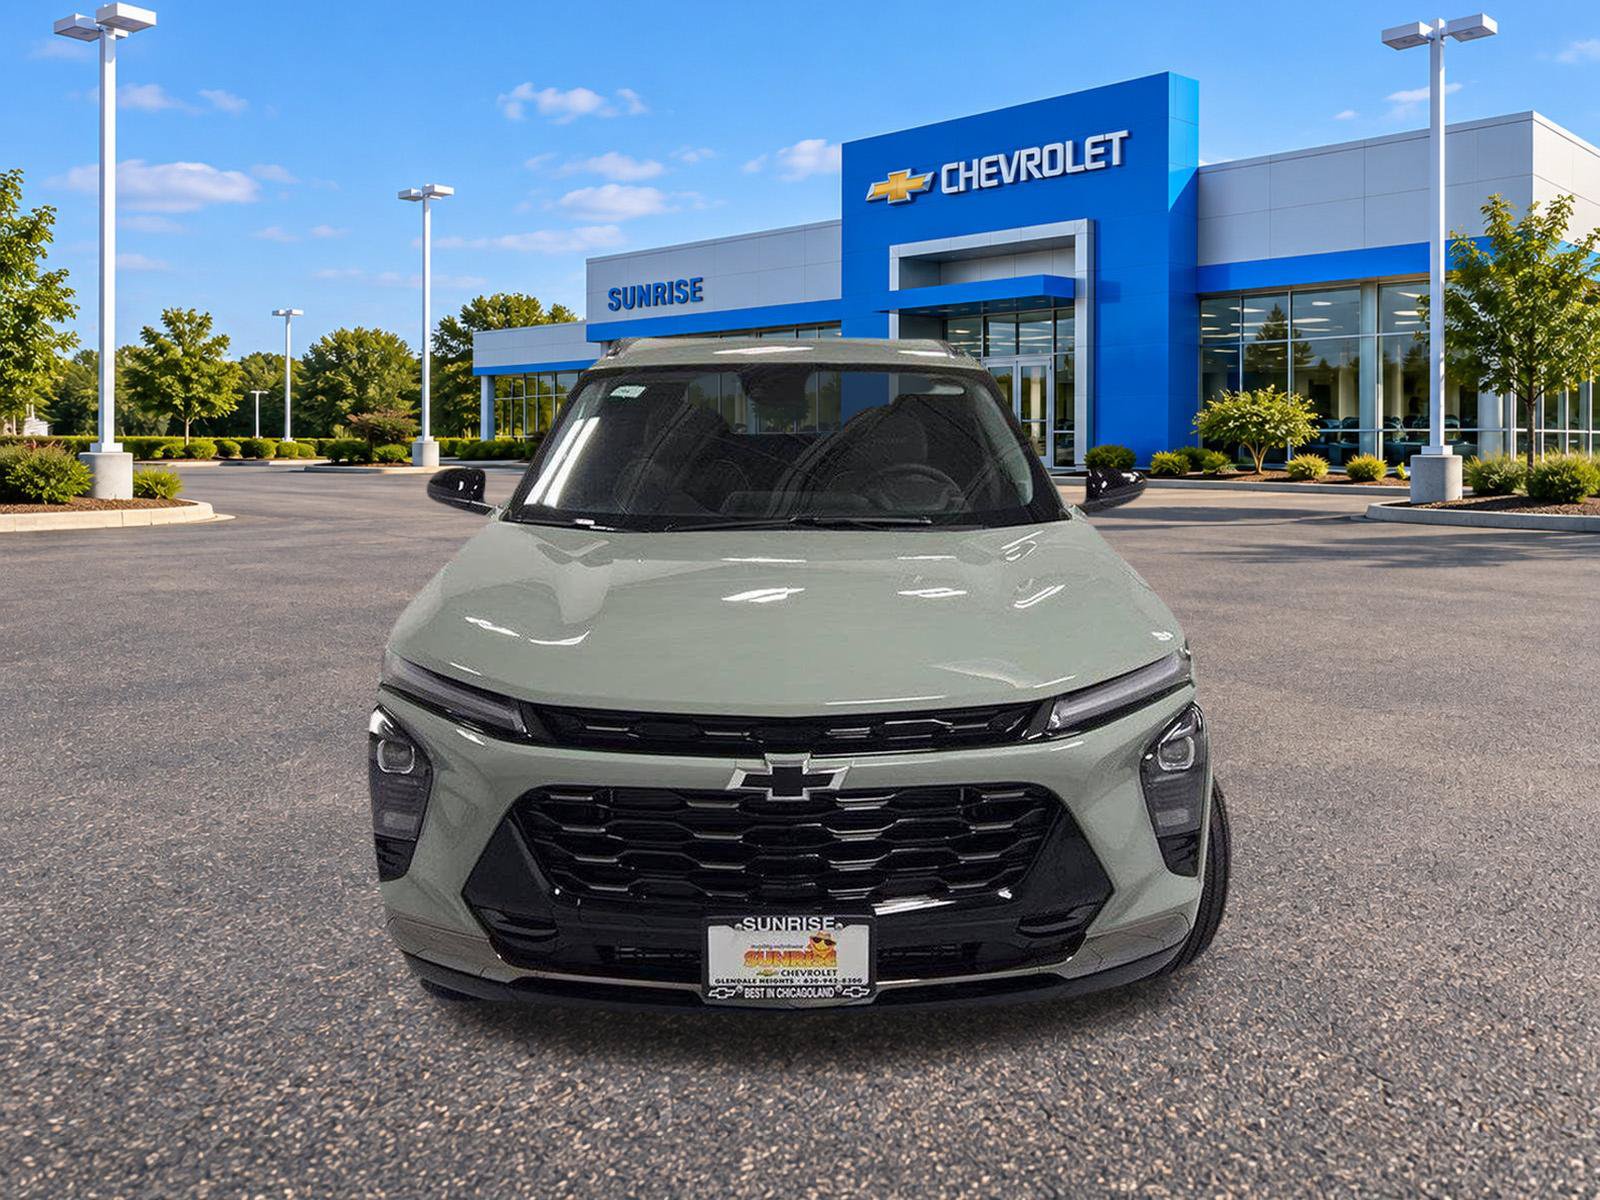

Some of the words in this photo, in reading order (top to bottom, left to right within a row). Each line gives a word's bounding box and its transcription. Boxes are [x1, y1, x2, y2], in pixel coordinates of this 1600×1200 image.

[941, 130, 1129, 194] CHEVROLET
[608, 277, 704, 311] SUNRISE
[742, 917, 835, 931] SUNRISE
[780, 969, 837, 977] CHEVROLET
[744, 988, 766, 998] BEST
[766, 988, 774, 998] IN
[775, 987, 834, 998] CHICAGOLAND
